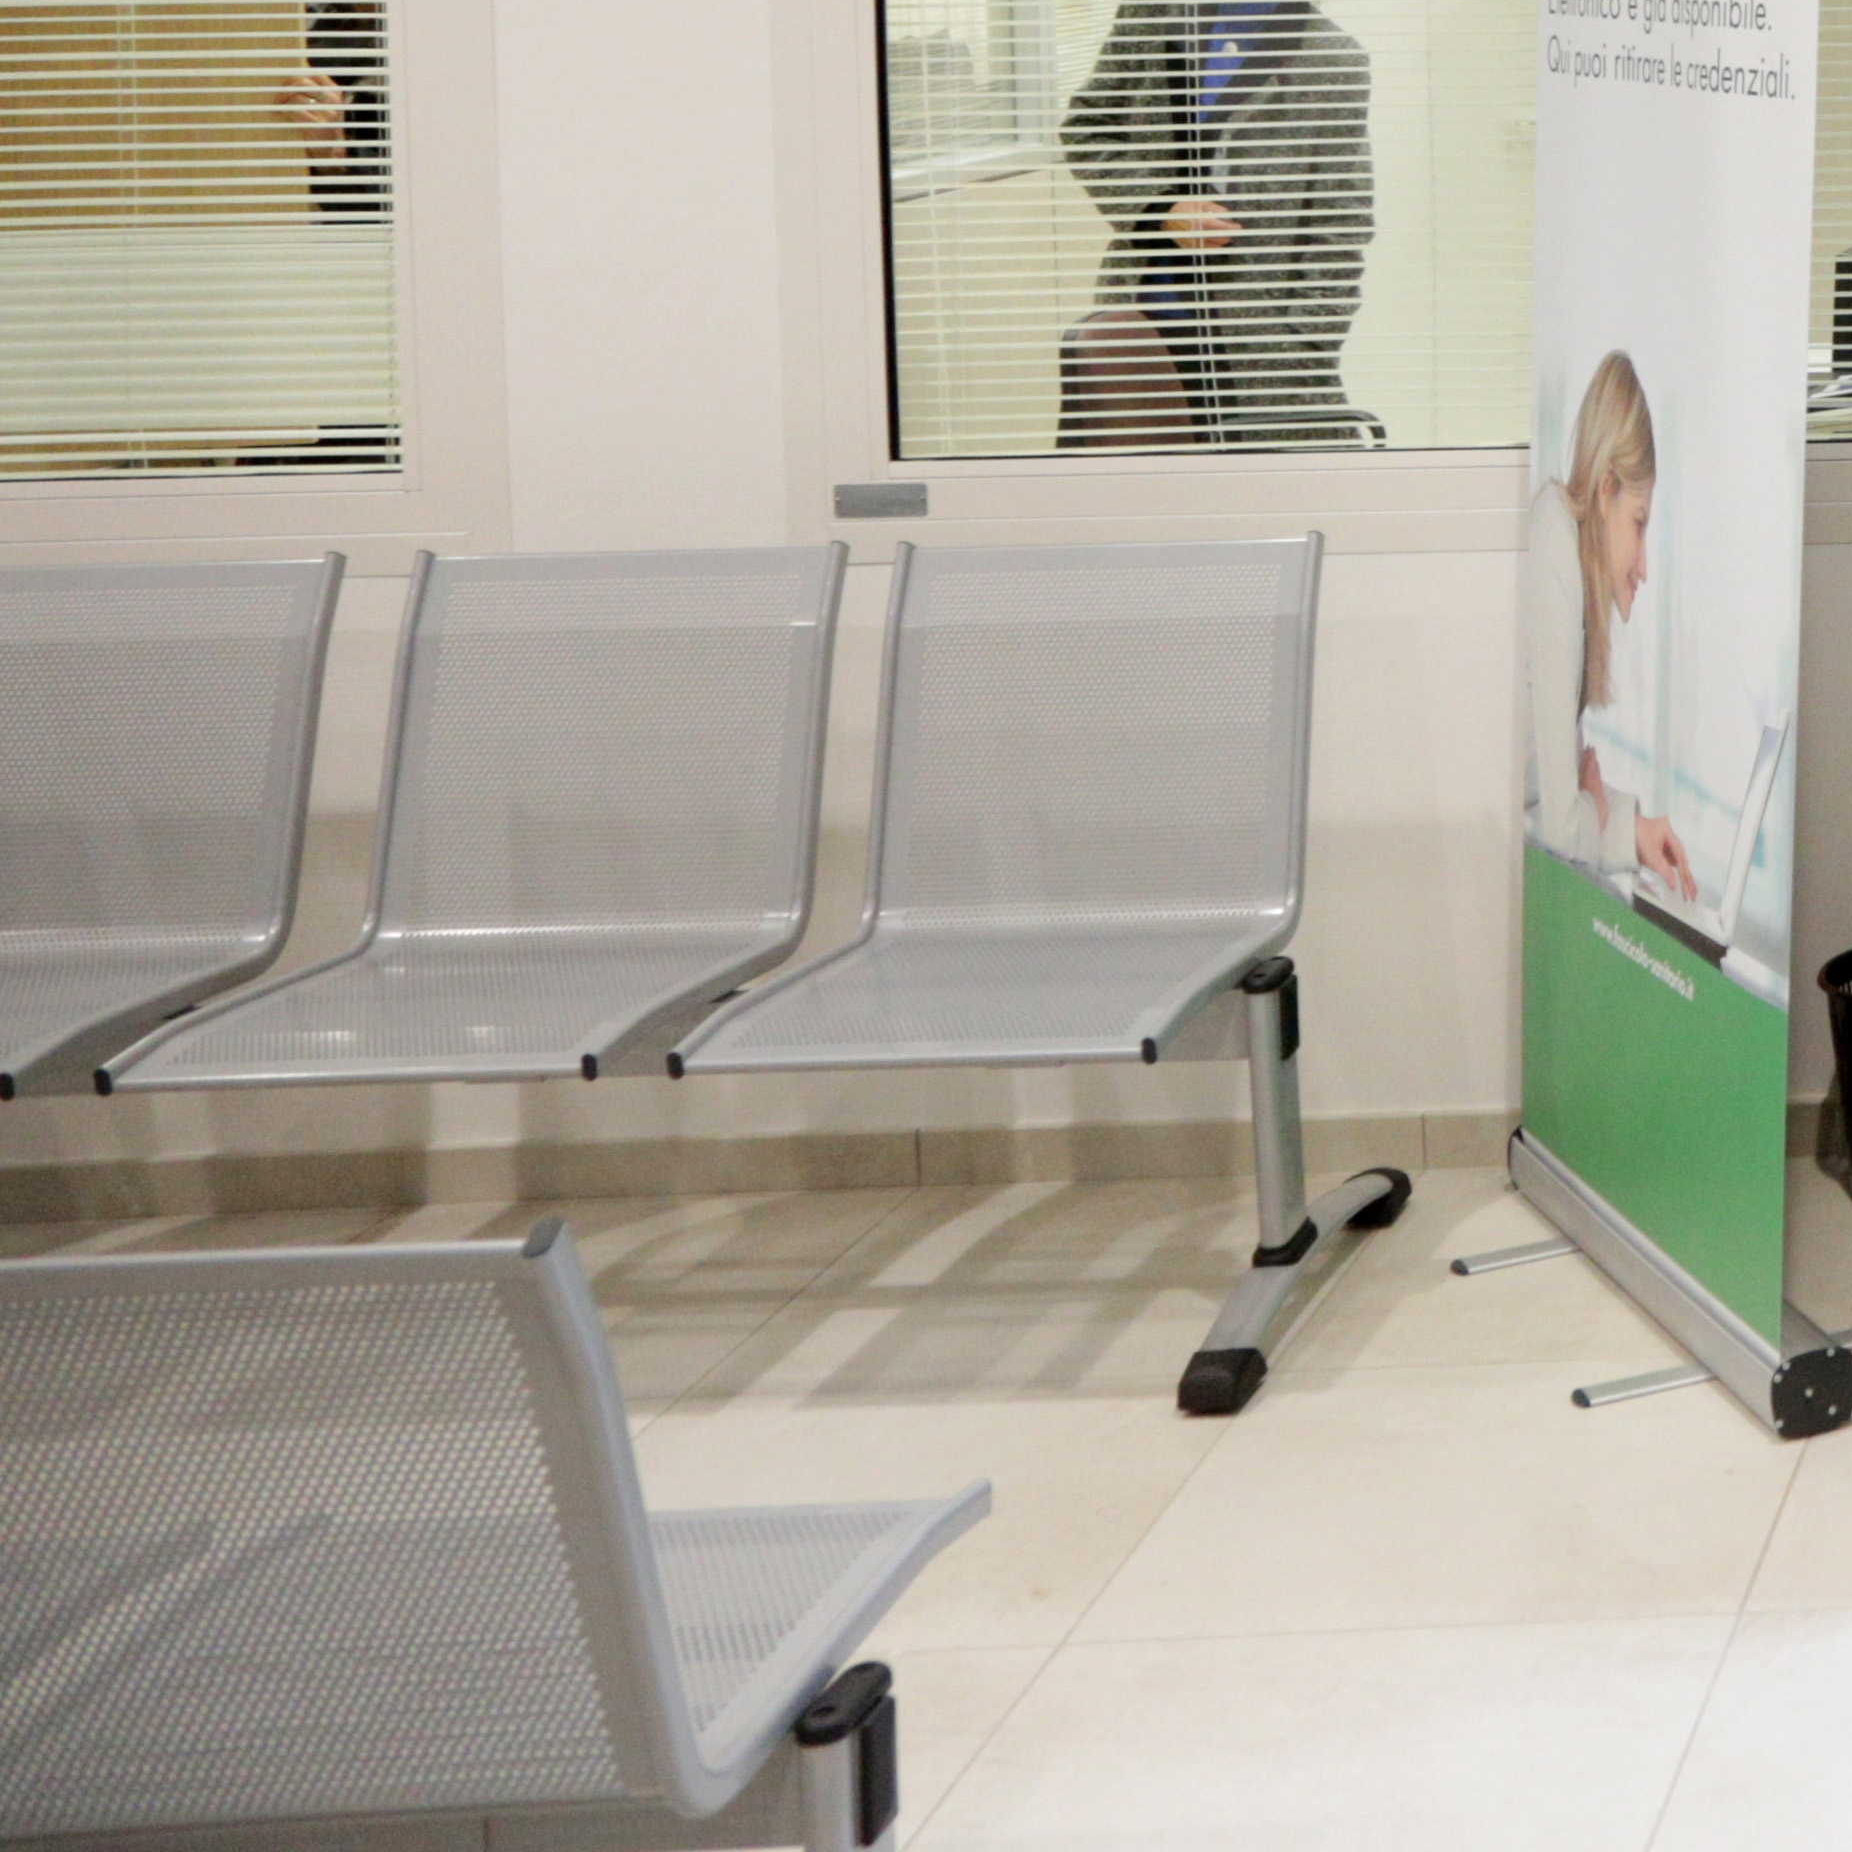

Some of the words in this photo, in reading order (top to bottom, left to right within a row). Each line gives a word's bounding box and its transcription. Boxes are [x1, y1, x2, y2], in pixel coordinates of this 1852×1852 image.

[1548, 36, 1571, 75] Qui
[1575, 43, 1607, 87] puoi
[1614, 44, 1665, 85] ritirare
[1670, 43, 1682, 87] le
[1686, 48, 1796, 100] credenziali.
